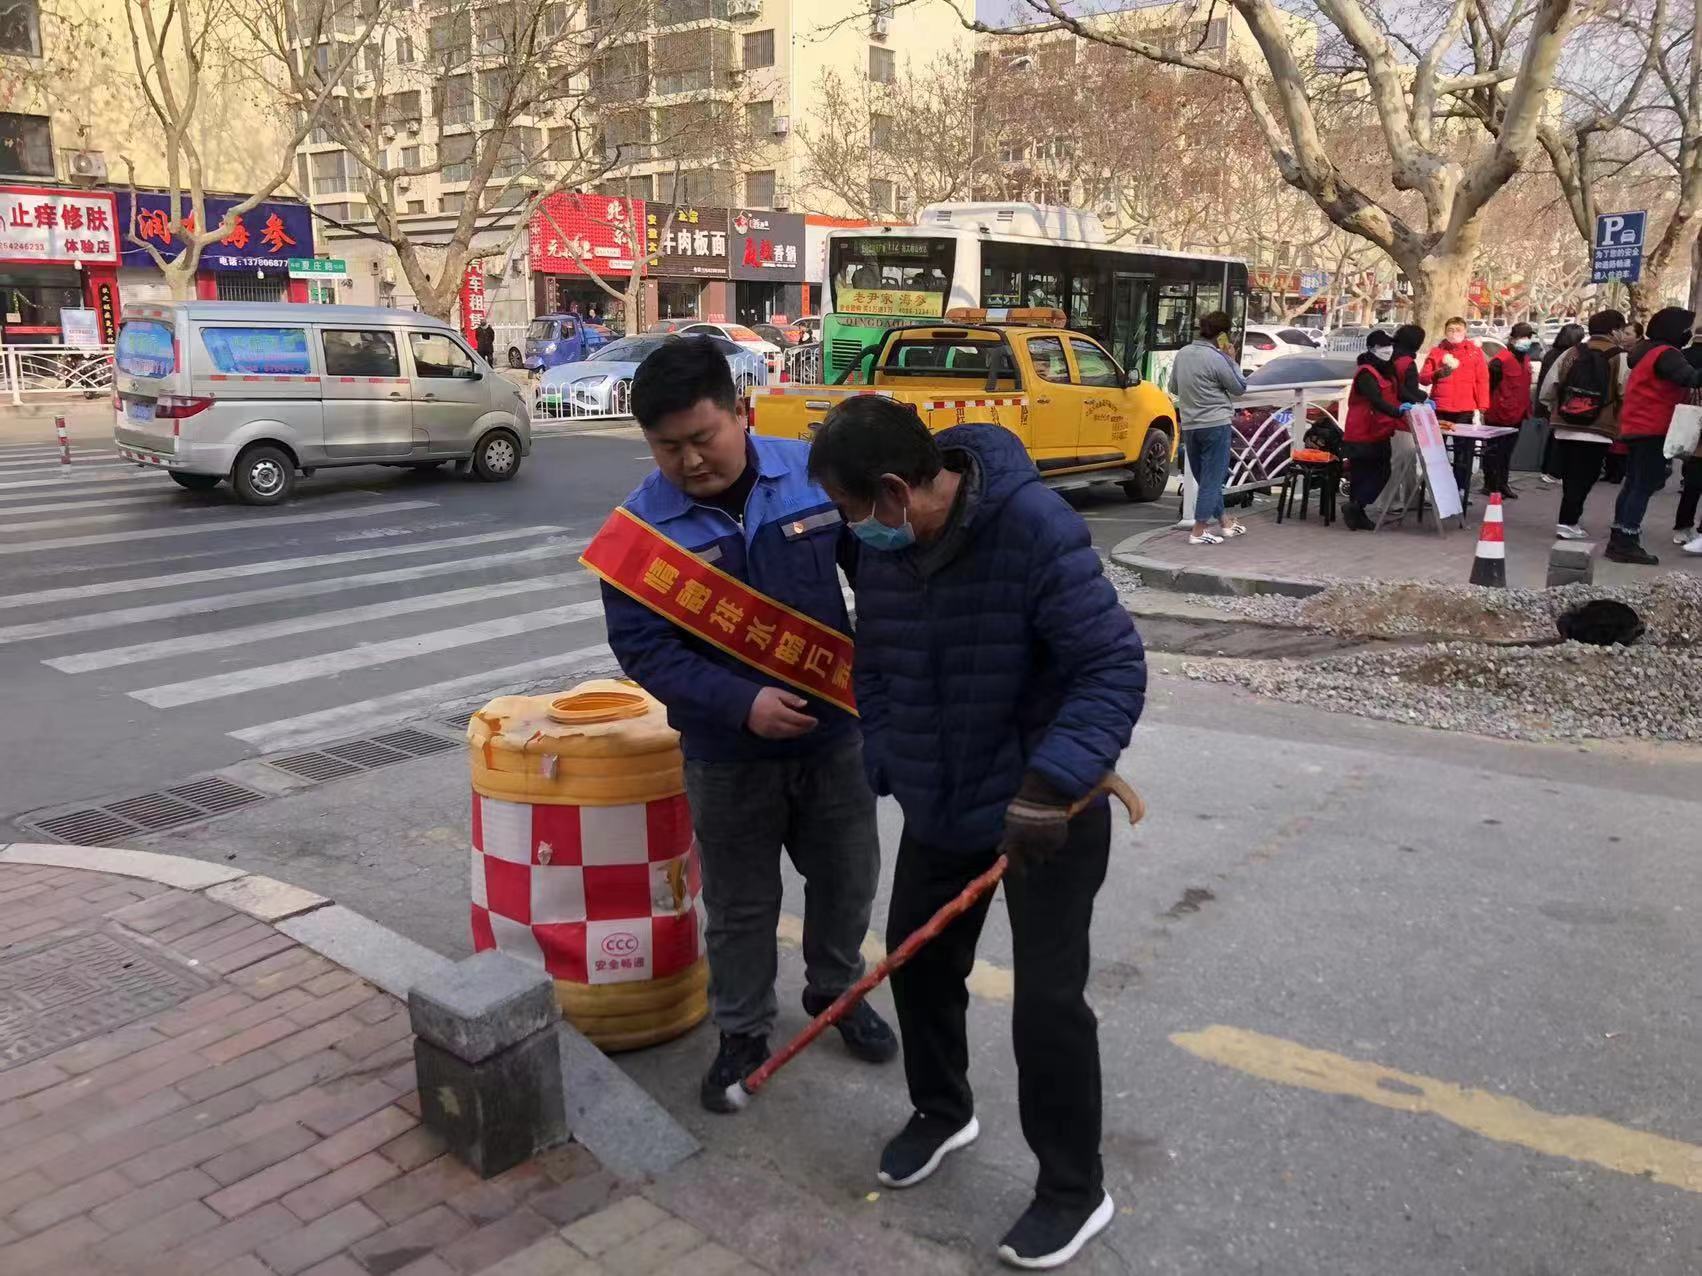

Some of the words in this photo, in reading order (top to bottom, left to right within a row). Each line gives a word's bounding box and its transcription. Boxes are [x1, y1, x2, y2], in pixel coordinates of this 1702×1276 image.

[10, 202, 109, 232] 止痒修肤
[136, 207, 297, 253] 润海参
[1601, 216, 1625, 246] P
[64, 238, 110, 254] 体验店
[662, 228, 727, 257] 牛肉板面
[1595, 247, 1640, 259] 为了您的安全
[302, 260, 333, 271] 夏庄路
[853, 291, 893, 305] 老尹家
[642, 556, 853, 690] 情融排水畅万家
[606, 938, 635, 951] CCC
[594, 957, 646, 971] 安全畅通
